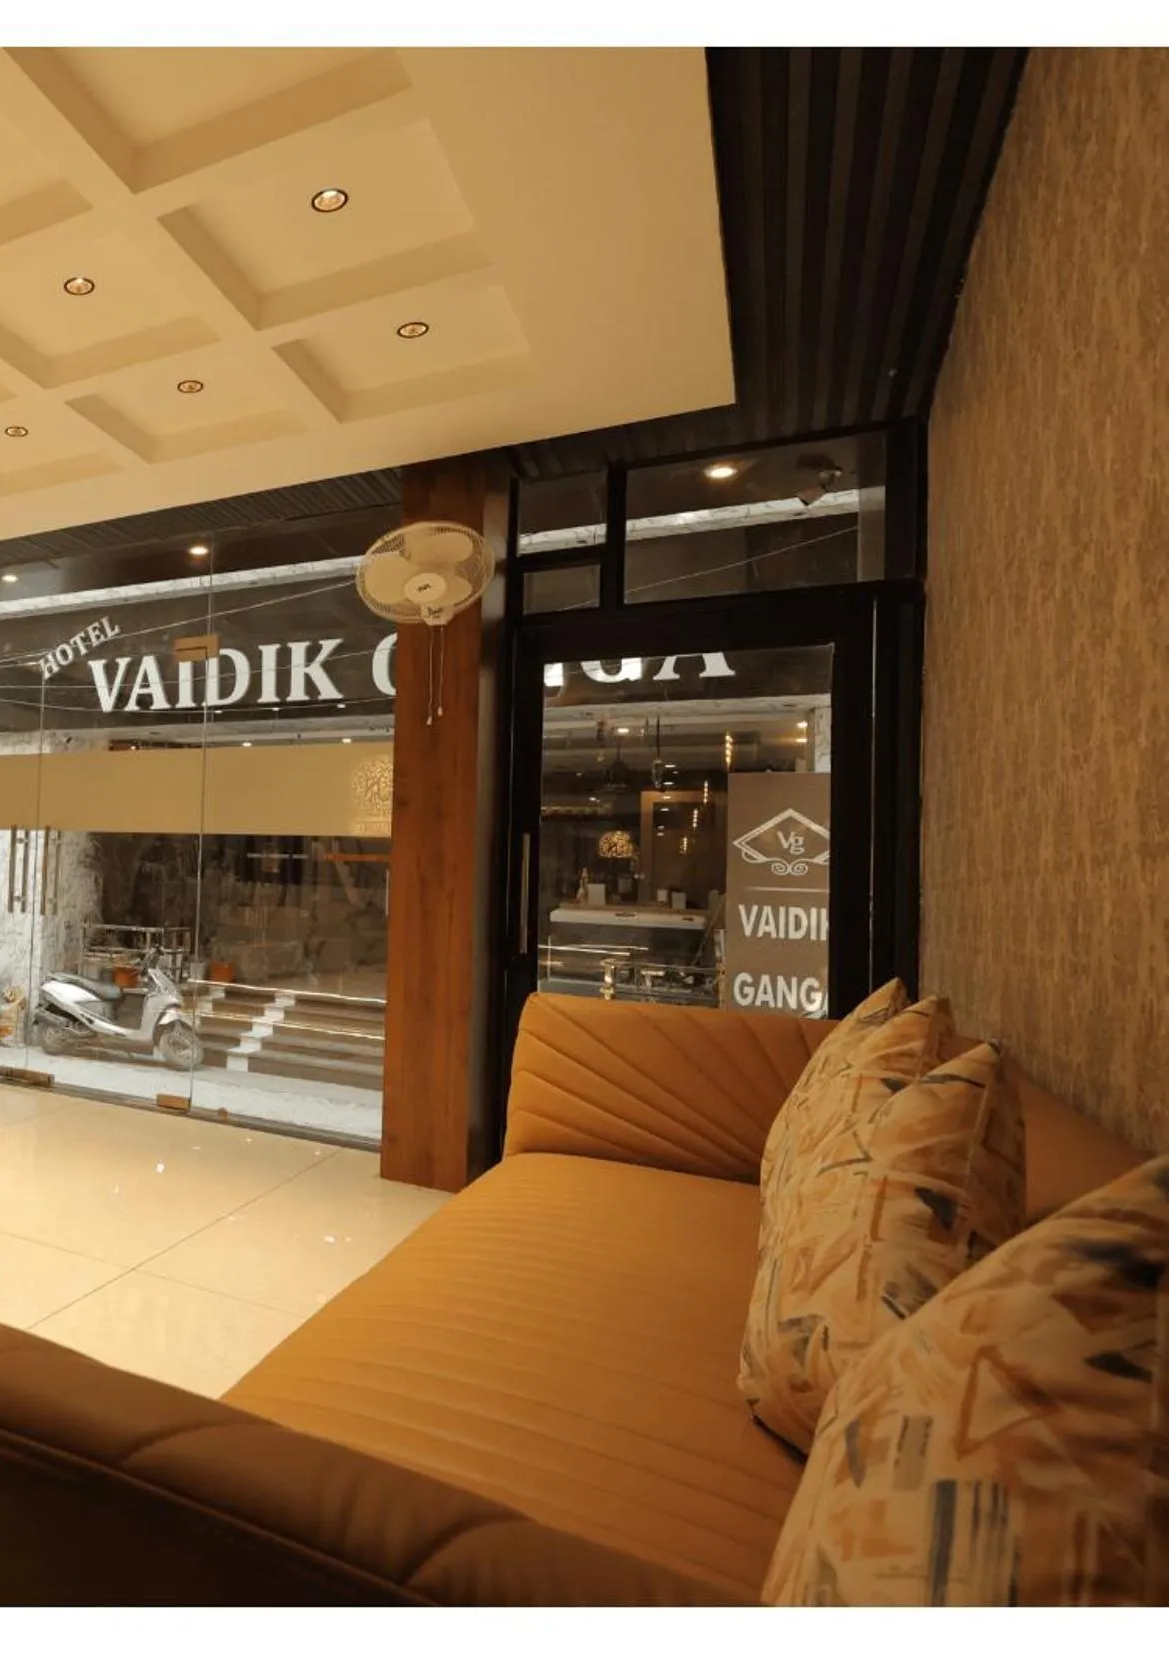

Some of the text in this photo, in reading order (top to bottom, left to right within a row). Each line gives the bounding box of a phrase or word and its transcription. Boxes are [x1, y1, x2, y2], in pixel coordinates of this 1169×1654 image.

[40, 616, 120, 680] HOTEL
[88, 638, 343, 713] VAIDIK
[733, 972, 828, 1012] GANG
